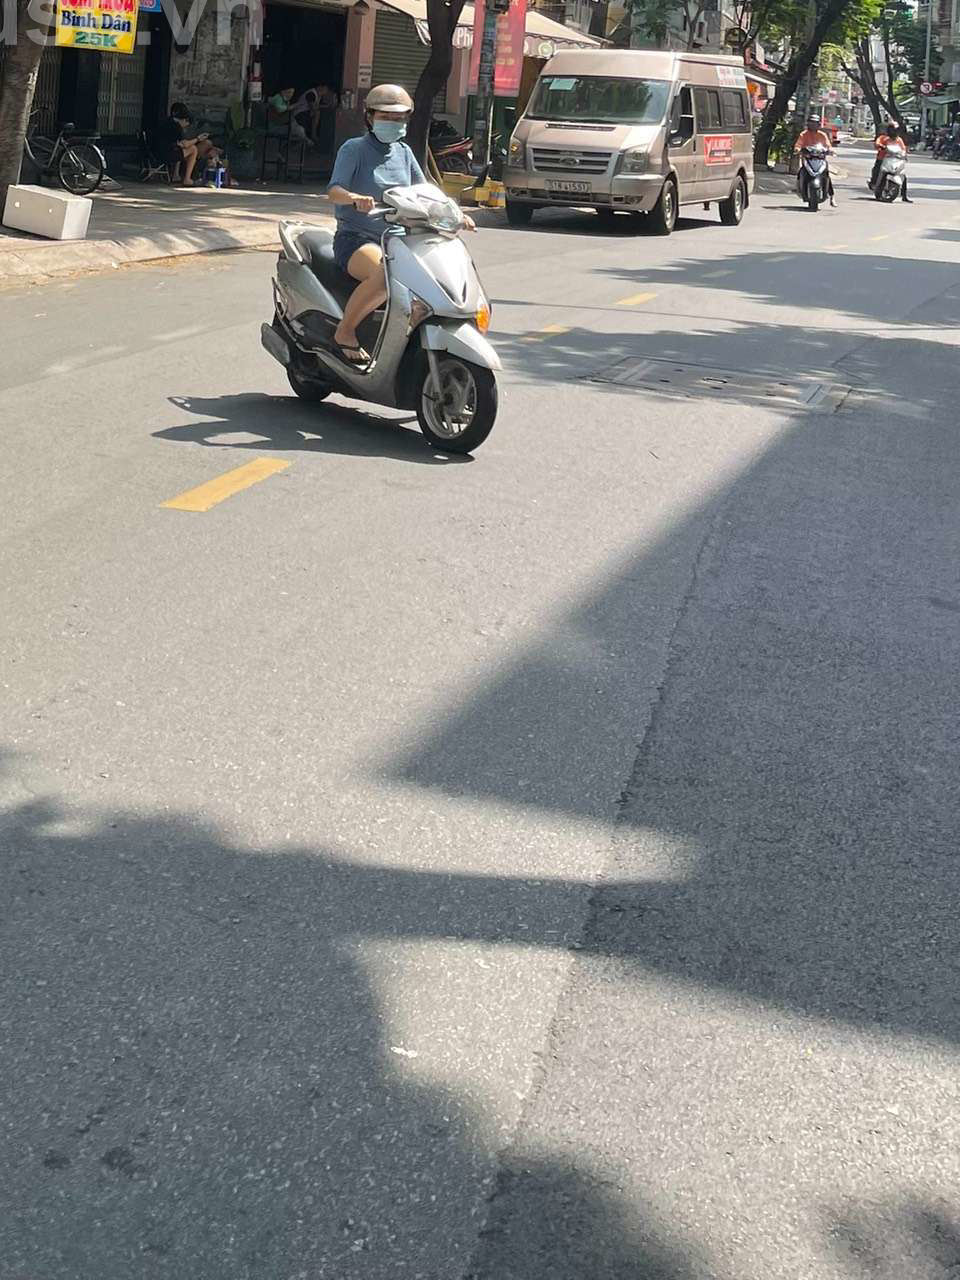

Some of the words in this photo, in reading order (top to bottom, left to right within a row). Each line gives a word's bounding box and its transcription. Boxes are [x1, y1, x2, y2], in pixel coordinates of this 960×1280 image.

[61, 10, 96, 28] Bình
[101, 14, 132, 32] Dân
[75, 31, 118, 47] 25K
